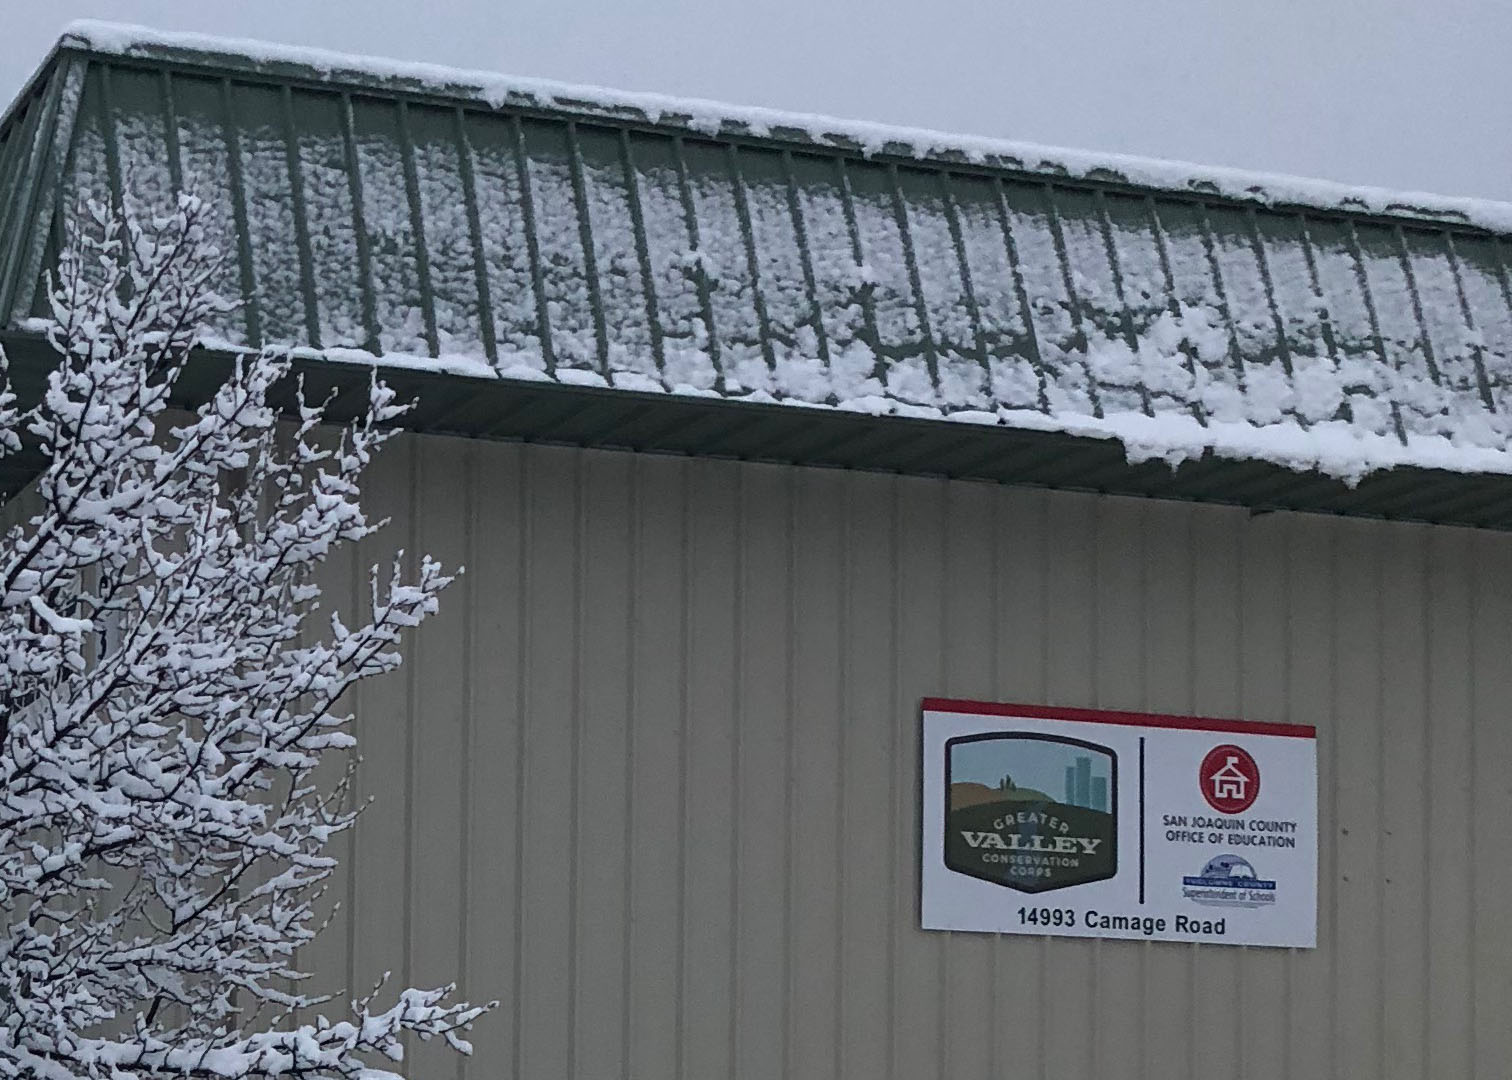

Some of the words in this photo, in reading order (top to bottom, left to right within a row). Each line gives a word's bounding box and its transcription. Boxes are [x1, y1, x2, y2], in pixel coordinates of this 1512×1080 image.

[993, 811, 1069, 834] GREATER
[1163, 815, 1187, 827] SAN
[1191, 816, 1245, 830] JOAQUIN
[1249, 820, 1297, 833] COUNTY
[960, 831, 1102, 855] VALLEY
[1166, 830, 1204, 843] OFFICE
[1208, 832, 1224, 844] OF
[1228, 834, 1295, 848] EDUCATION
[982, 853, 1079, 867] CONSERVATION
[1010, 866, 1051, 877] CORPS
[1018, 907, 1075, 927] 14993
[1085, 910, 1166, 935] Camage
[1176, 915, 1225, 935] Road
